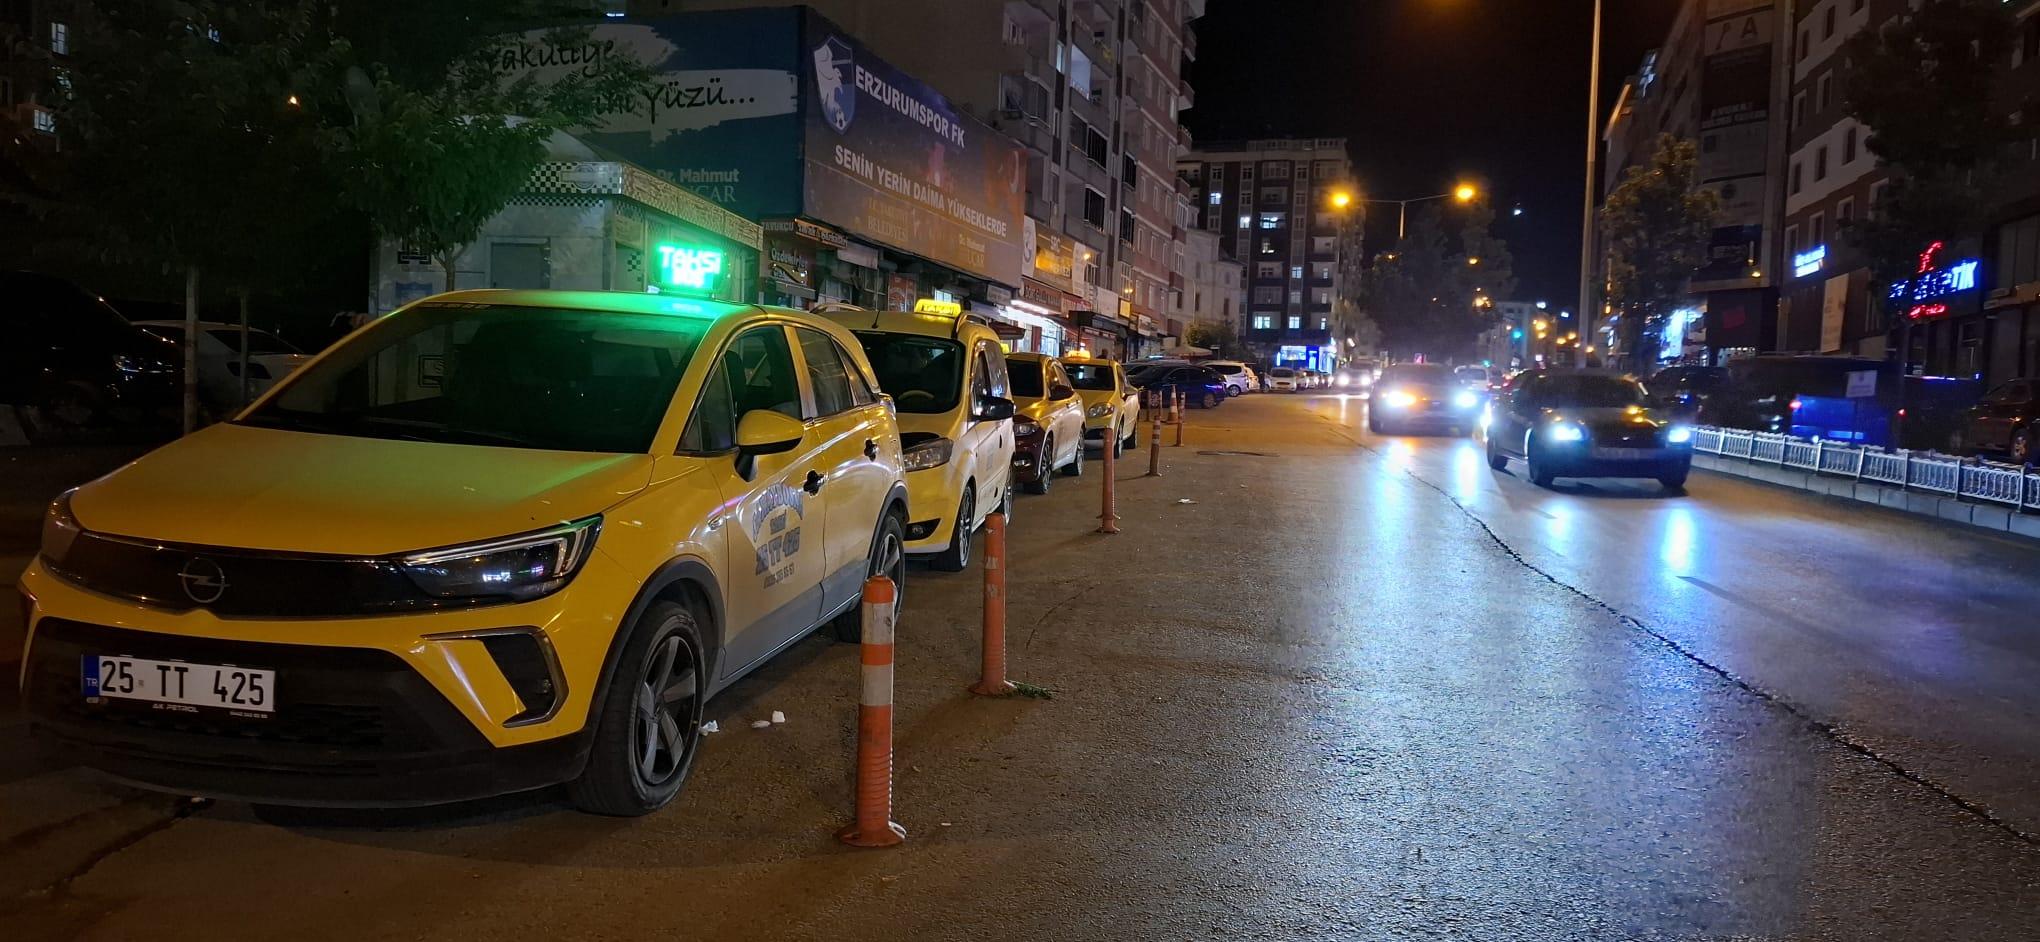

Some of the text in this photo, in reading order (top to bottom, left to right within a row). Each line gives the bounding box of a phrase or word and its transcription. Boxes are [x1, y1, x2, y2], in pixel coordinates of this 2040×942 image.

[497, 38, 614, 78] akutiye
[855, 64, 966, 149] ERZURUMSPOR FK
[679, 168, 740, 183] Mahmut
[835, 144, 874, 181] SENİN
[876, 166, 911, 198] YERİN
[913, 182, 946, 211] DAİMA
[946, 196, 1008, 238] YÜKSEKLERDE
[86, 677, 98, 688] TR
[101, 660, 264, 706] 25 TT 425
[166, 703, 199, 713] PETROL
